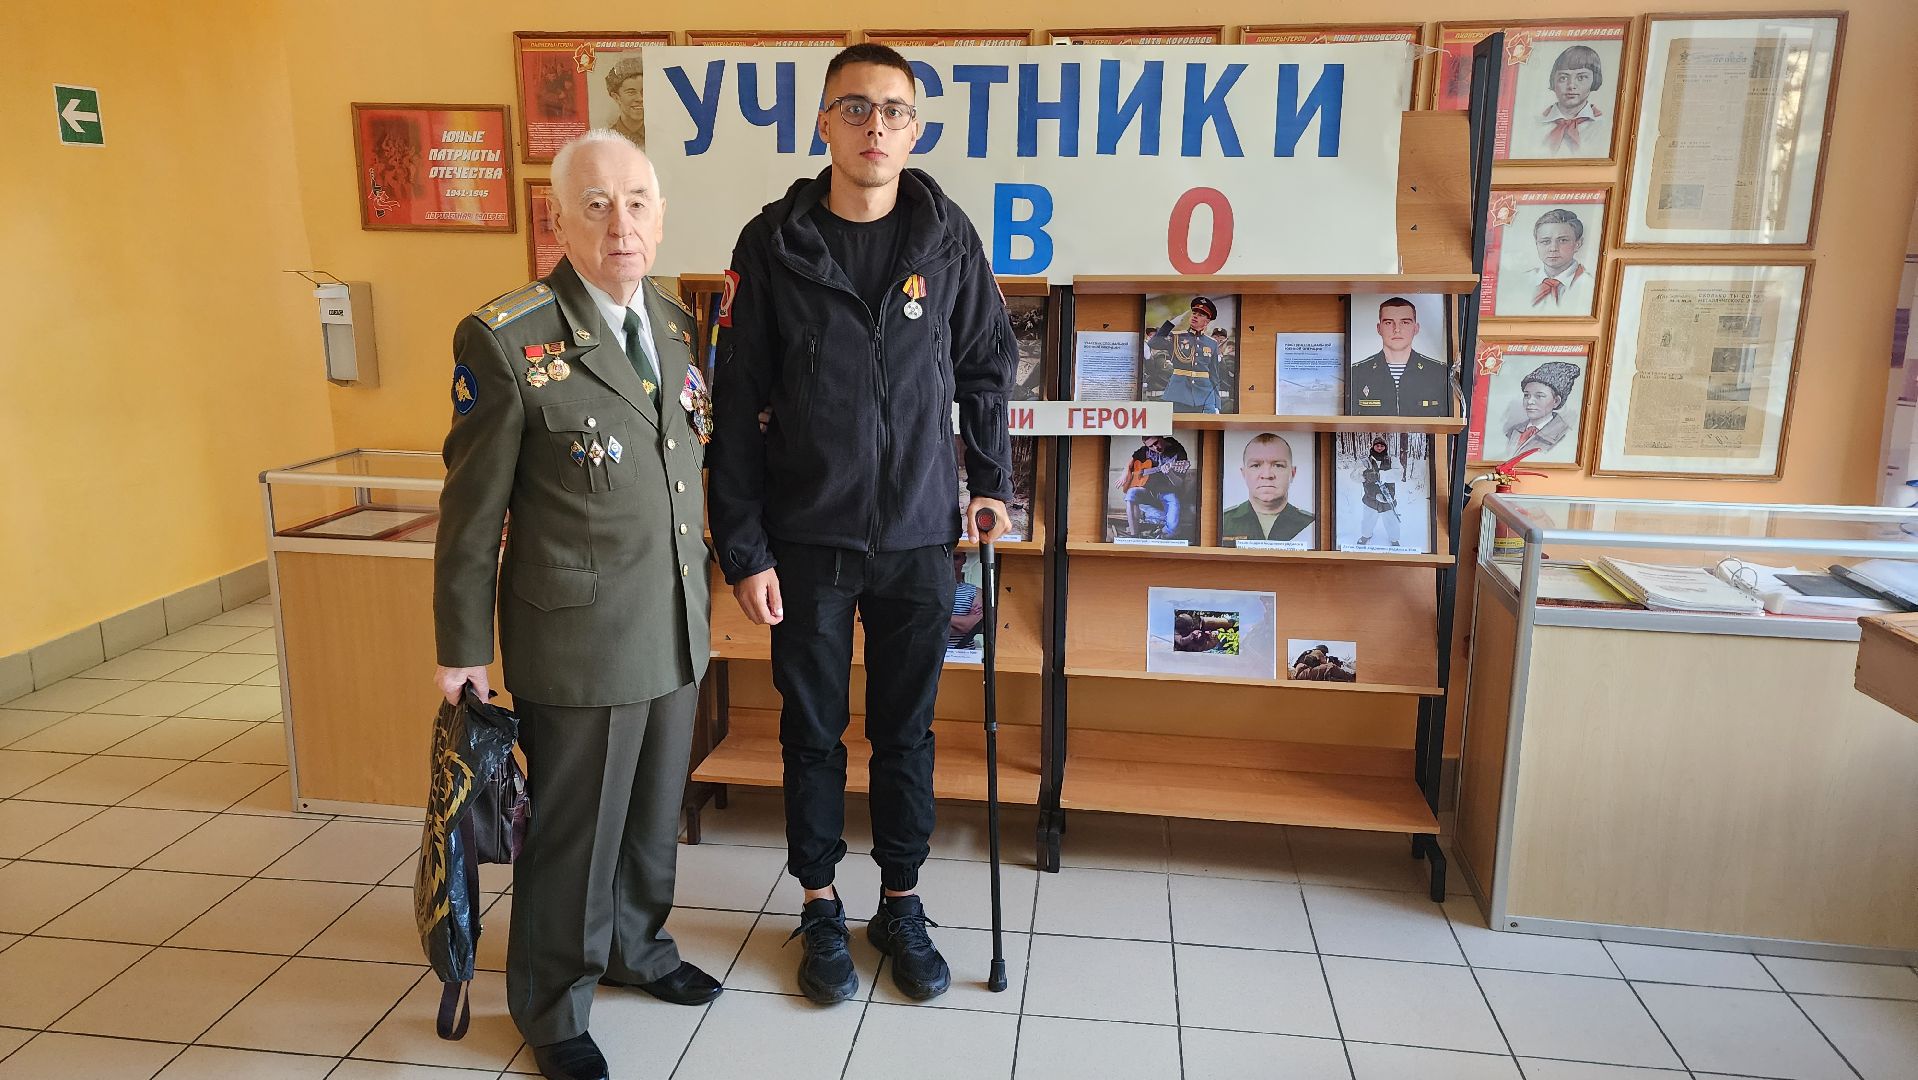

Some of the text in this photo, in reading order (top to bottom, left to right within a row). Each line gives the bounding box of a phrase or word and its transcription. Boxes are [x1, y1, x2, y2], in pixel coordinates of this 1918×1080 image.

[1535, 29, 1622, 38] ЗИНА ПОРТНОВА
[807, 39, 836, 47] КАЗЕЙ
[662, 59, 1345, 158] УЧСТНИКИ
[442, 130, 486, 143] ЮНЫЕ
[428, 148, 501, 162] ПАТРИОТЫ
[428, 166, 503, 179] ОТЕЧЕСТВА
[445, 189, 489, 198] 1941-1945
[425, 211, 473, 220] ПОРТРЕТНАЯ
[1068, 408, 1147, 430] ГЕРОИ
